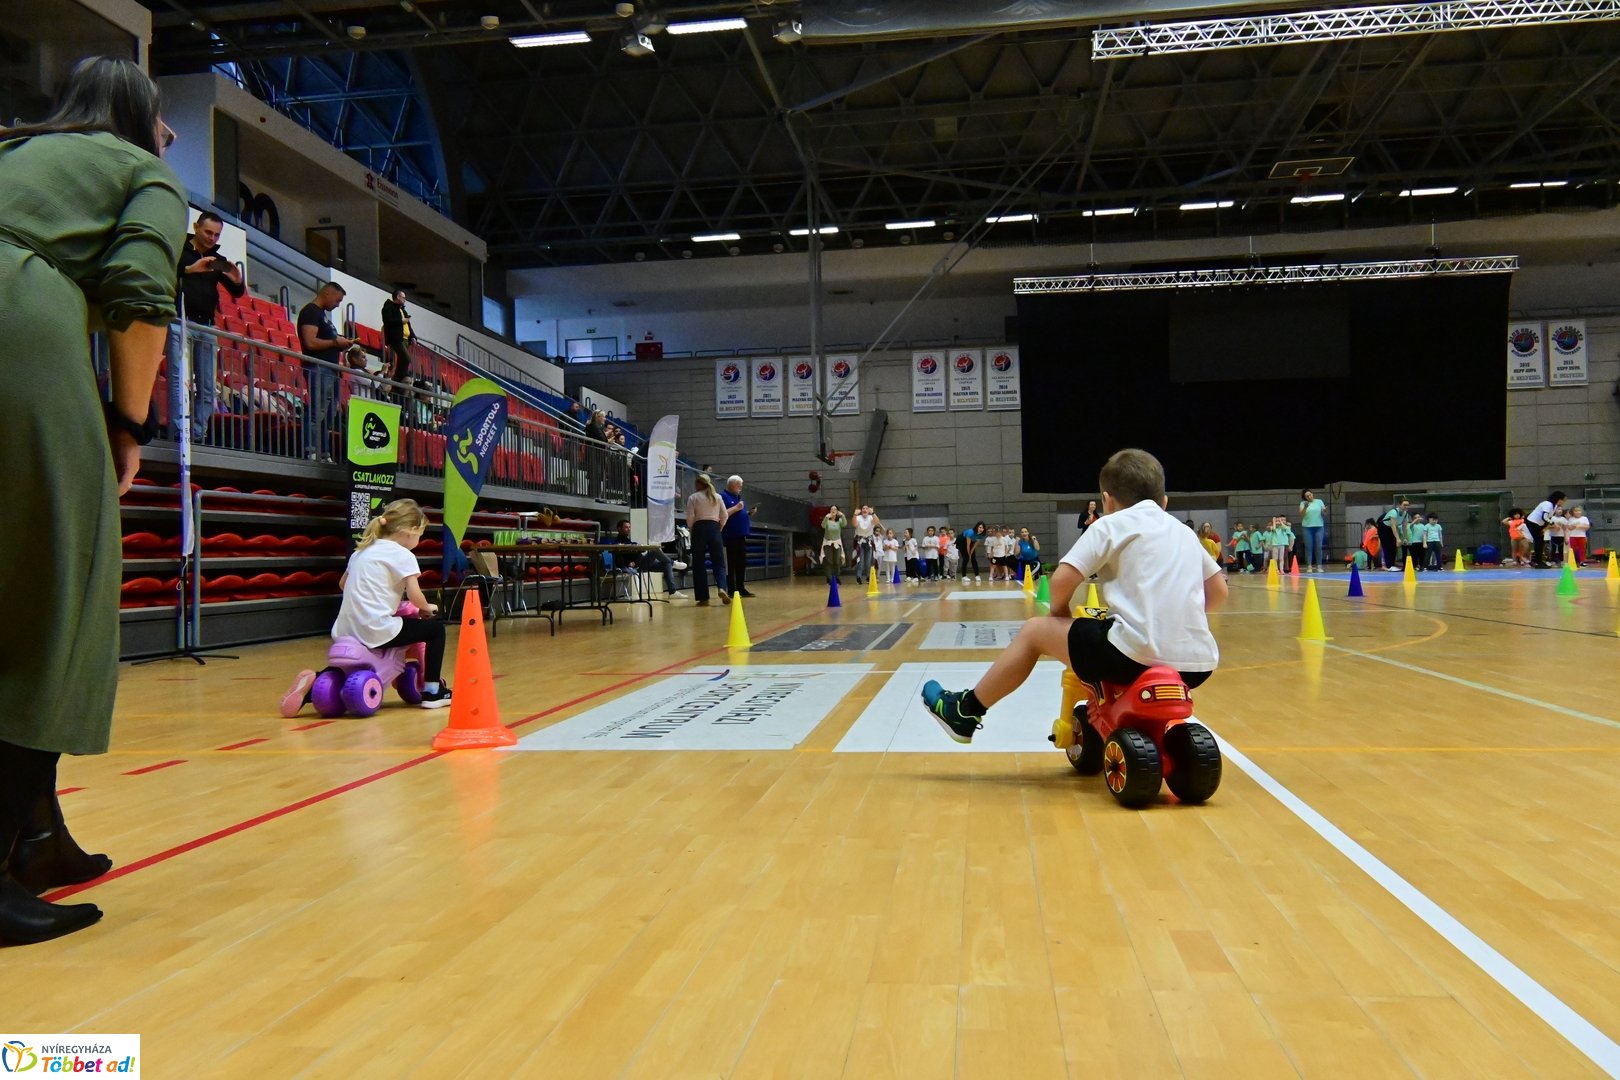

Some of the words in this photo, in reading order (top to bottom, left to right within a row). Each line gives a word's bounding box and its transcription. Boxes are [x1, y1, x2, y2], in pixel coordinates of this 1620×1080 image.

[475, 402, 500, 446] SPORTOLÓ
[479, 423, 498, 458] NEMZET
[352, 470, 395, 485] CSATLAKOZZ
[619, 683, 752, 739] SPORTCENTRUM
[711, 682, 805, 725] NYÍREGYHÁZI
